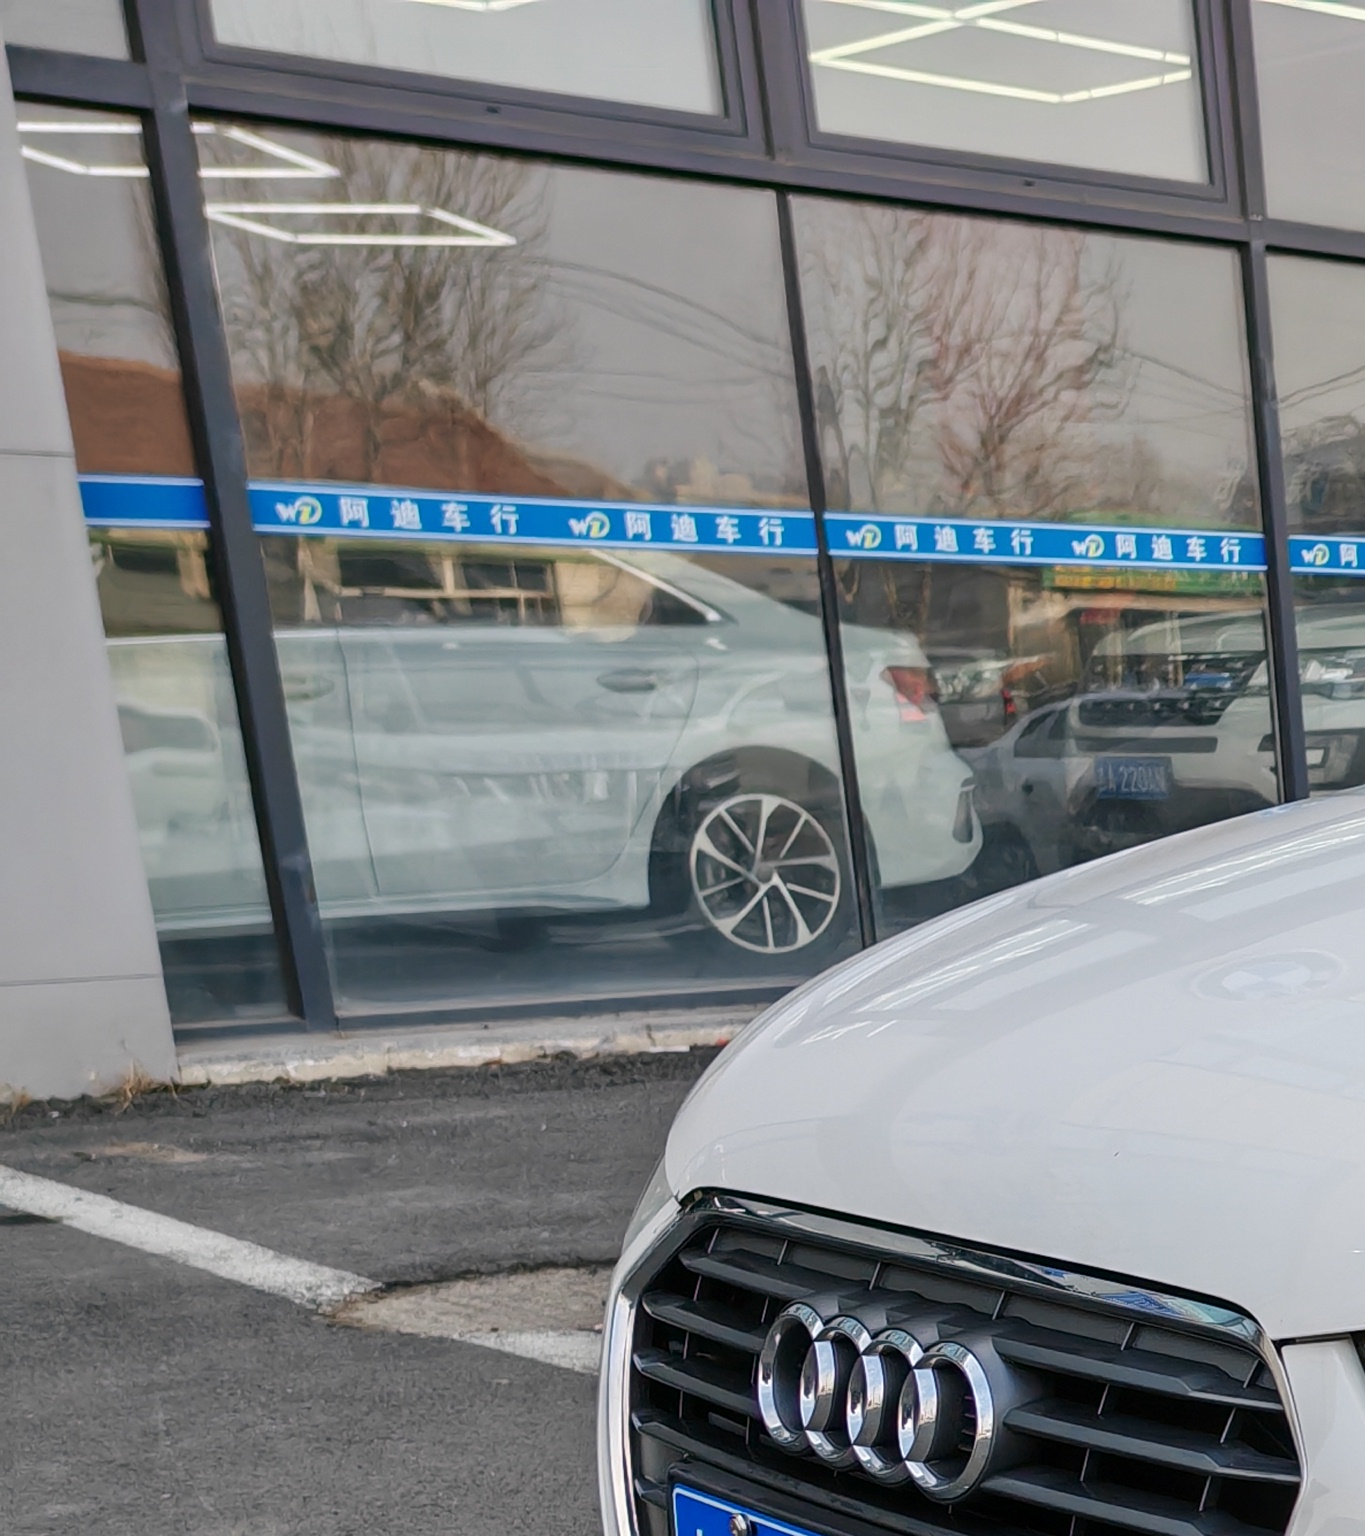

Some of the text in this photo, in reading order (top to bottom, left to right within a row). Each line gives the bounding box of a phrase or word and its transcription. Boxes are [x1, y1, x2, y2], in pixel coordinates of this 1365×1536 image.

[340, 497, 519, 535] 阿迪车行
[624, 511, 784, 546] 阿迪车行
[894, 524, 1033, 555] 阿迪车行
[1115, 534, 1241, 563] 阿迪车行
